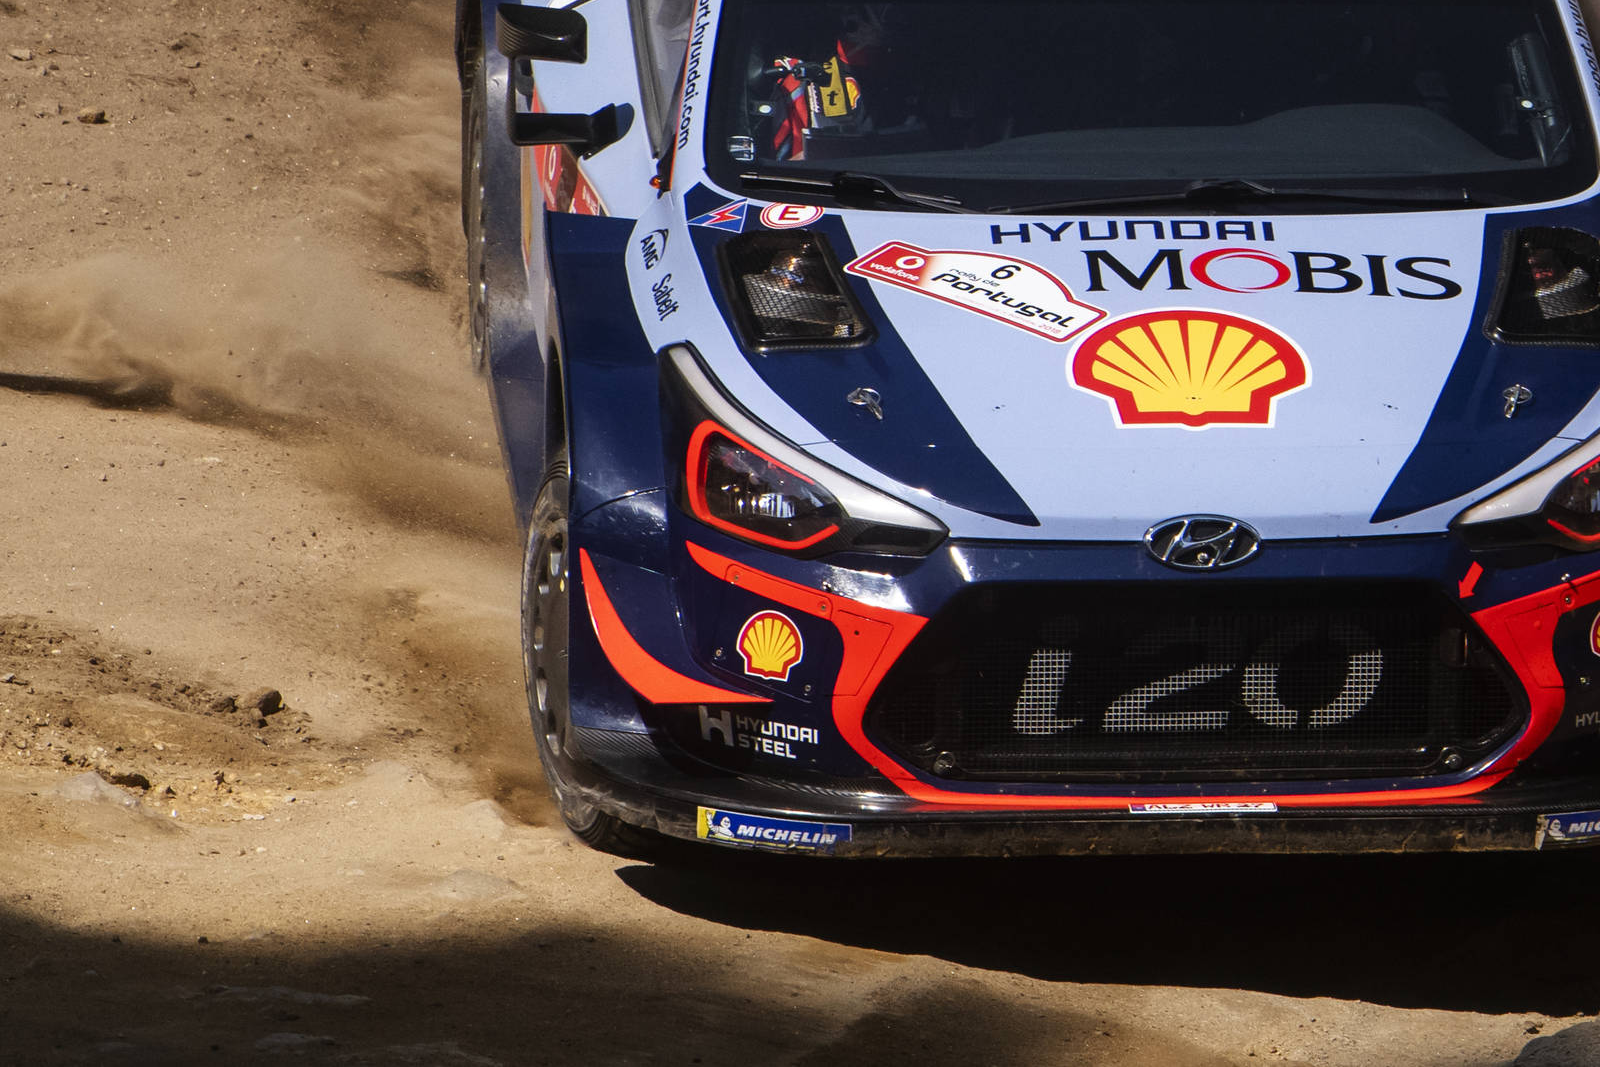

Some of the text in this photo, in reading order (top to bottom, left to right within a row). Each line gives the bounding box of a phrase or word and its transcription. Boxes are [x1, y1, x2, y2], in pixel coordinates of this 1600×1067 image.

[779, 205, 801, 221] E
[990, 220, 1275, 245] HYUNDAI
[870, 262, 919, 282] vodafone
[949, 268, 981, 282] rally
[990, 264, 1022, 280] 6
[1080, 248, 1462, 301] MOBIS
[651, 273, 680, 322] Sabelt
[930, 273, 1075, 328] Portugal
[736, 715, 818, 744] HYUNDAI
[738, 734, 797, 759] STEEL
[736, 824, 837, 844] MICHELIN
